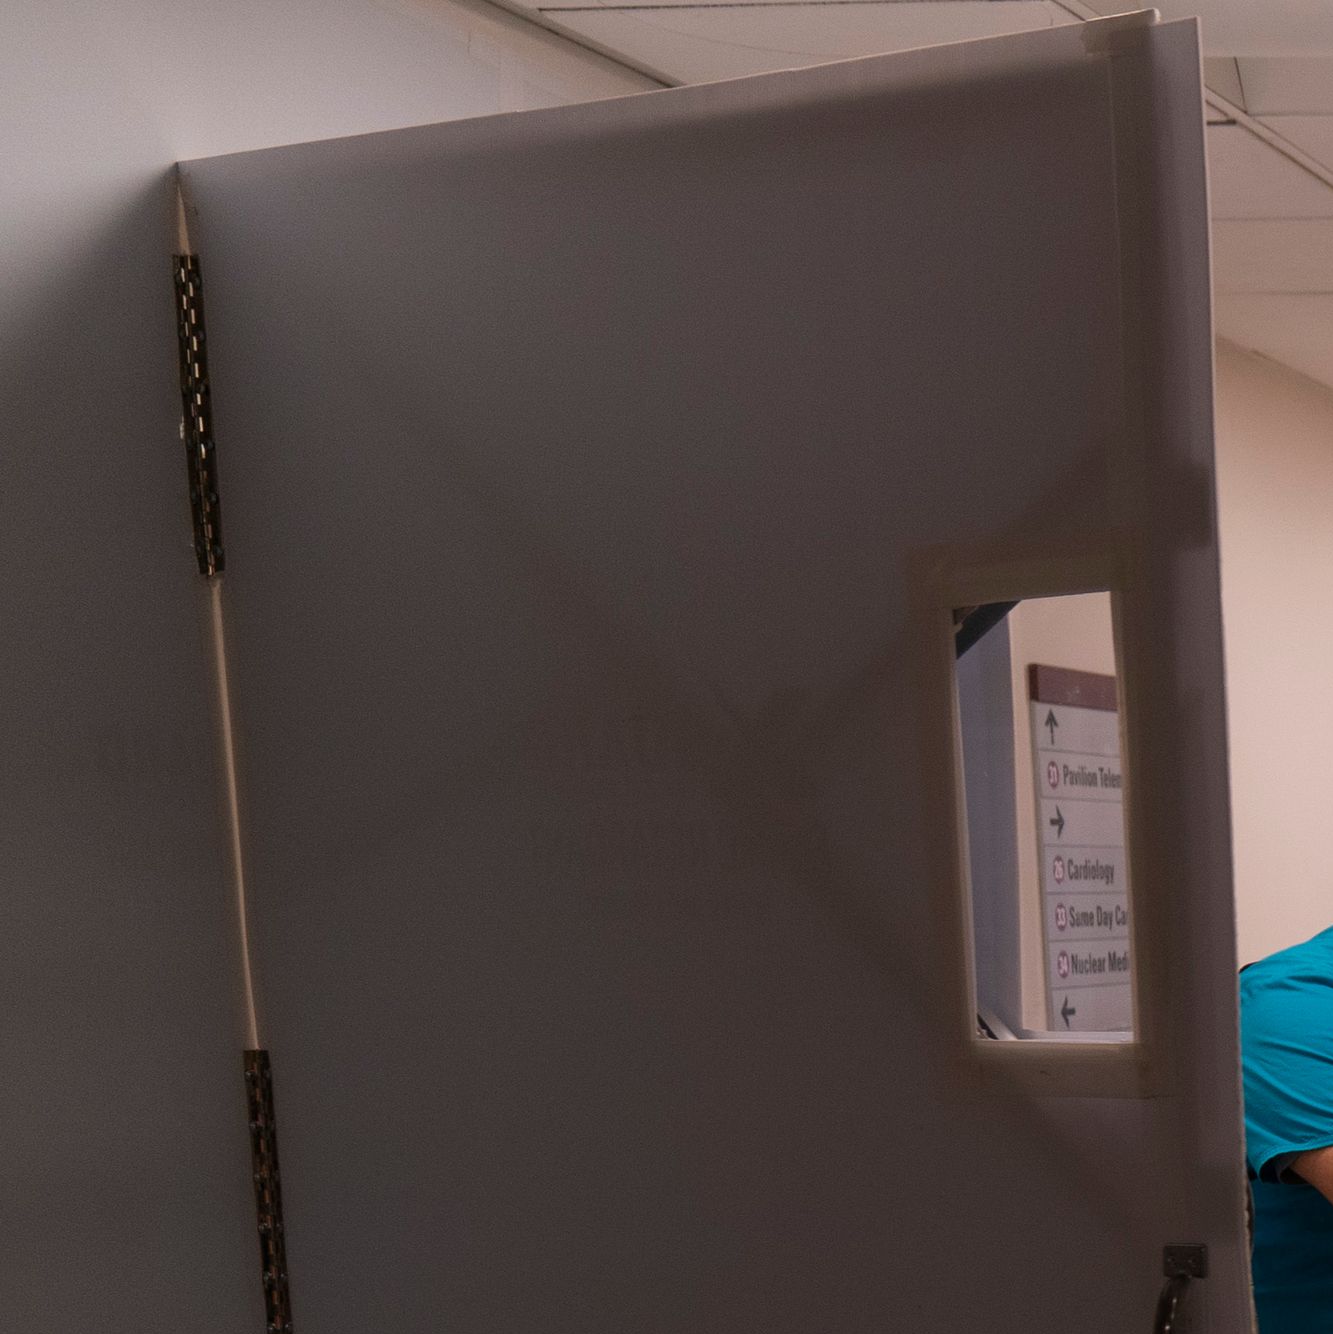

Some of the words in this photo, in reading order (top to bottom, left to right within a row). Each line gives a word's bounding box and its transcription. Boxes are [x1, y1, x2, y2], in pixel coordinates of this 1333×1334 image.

[1063, 764, 1098, 787] Pavilion
[1067, 859, 1115, 885] Cardiology
[1069, 906, 1095, 928] Same
[1096, 905, 1114, 931] Day
[1071, 952, 1106, 975] Nuclear
